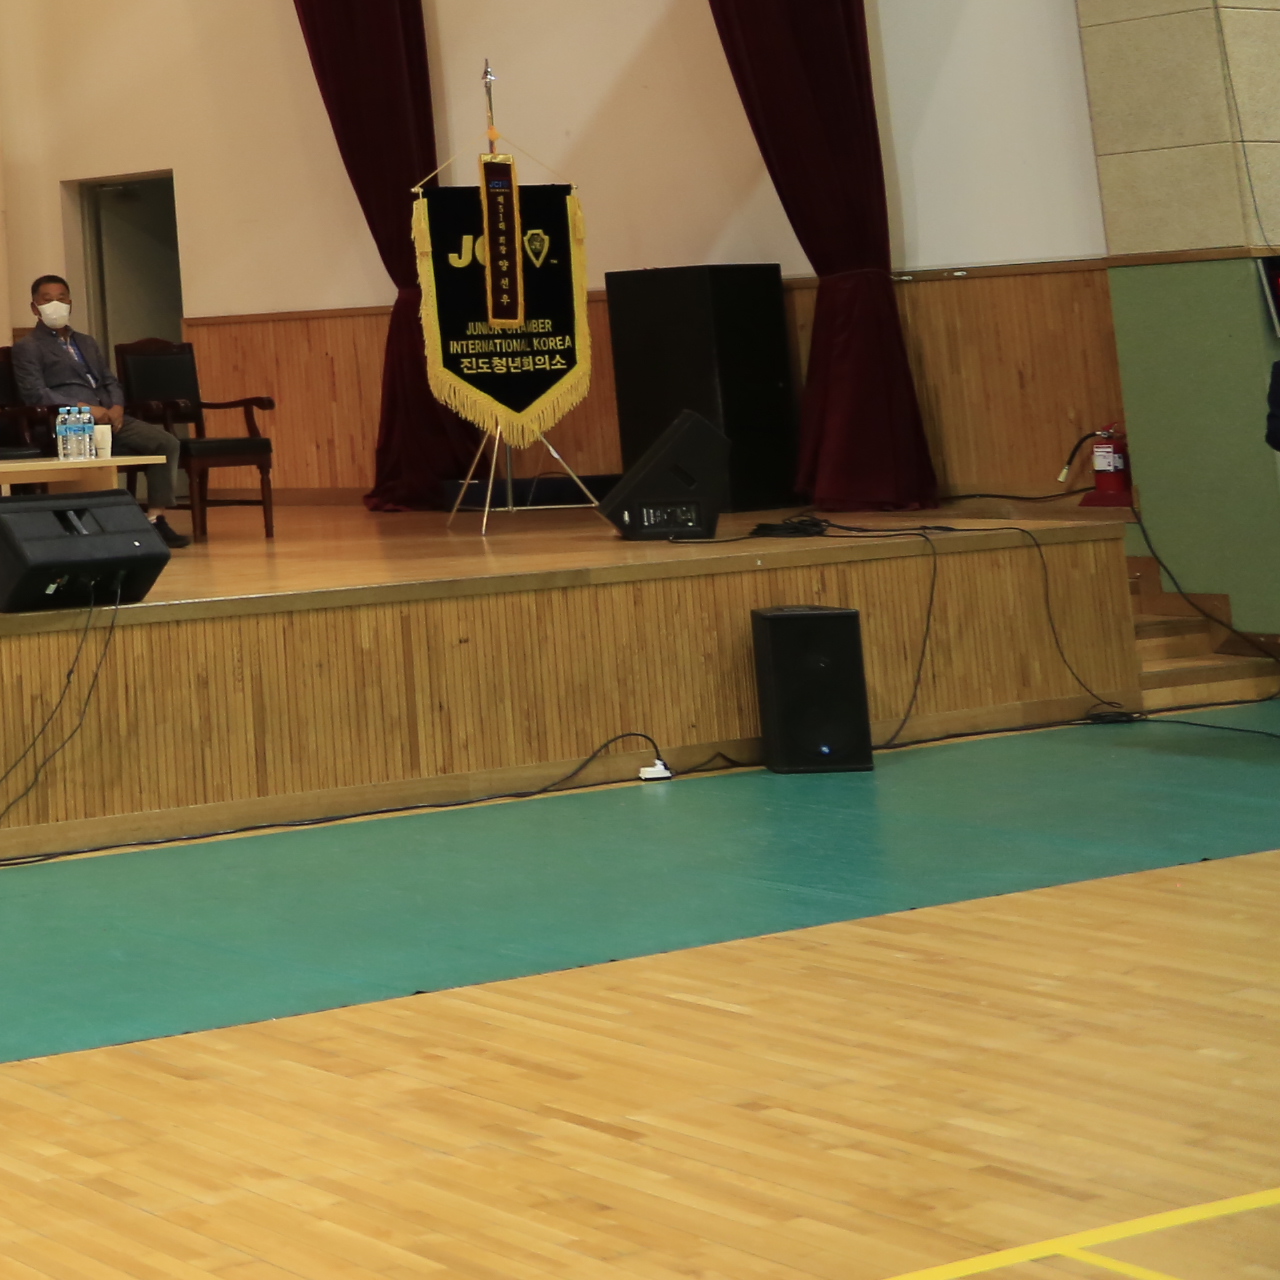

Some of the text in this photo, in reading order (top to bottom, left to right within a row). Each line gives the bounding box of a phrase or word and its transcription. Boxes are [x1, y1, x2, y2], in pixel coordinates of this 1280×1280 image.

[449, 335, 572, 354] INTERNATIONAL KOREA
[460, 354, 567, 374] 진도청년회의소
